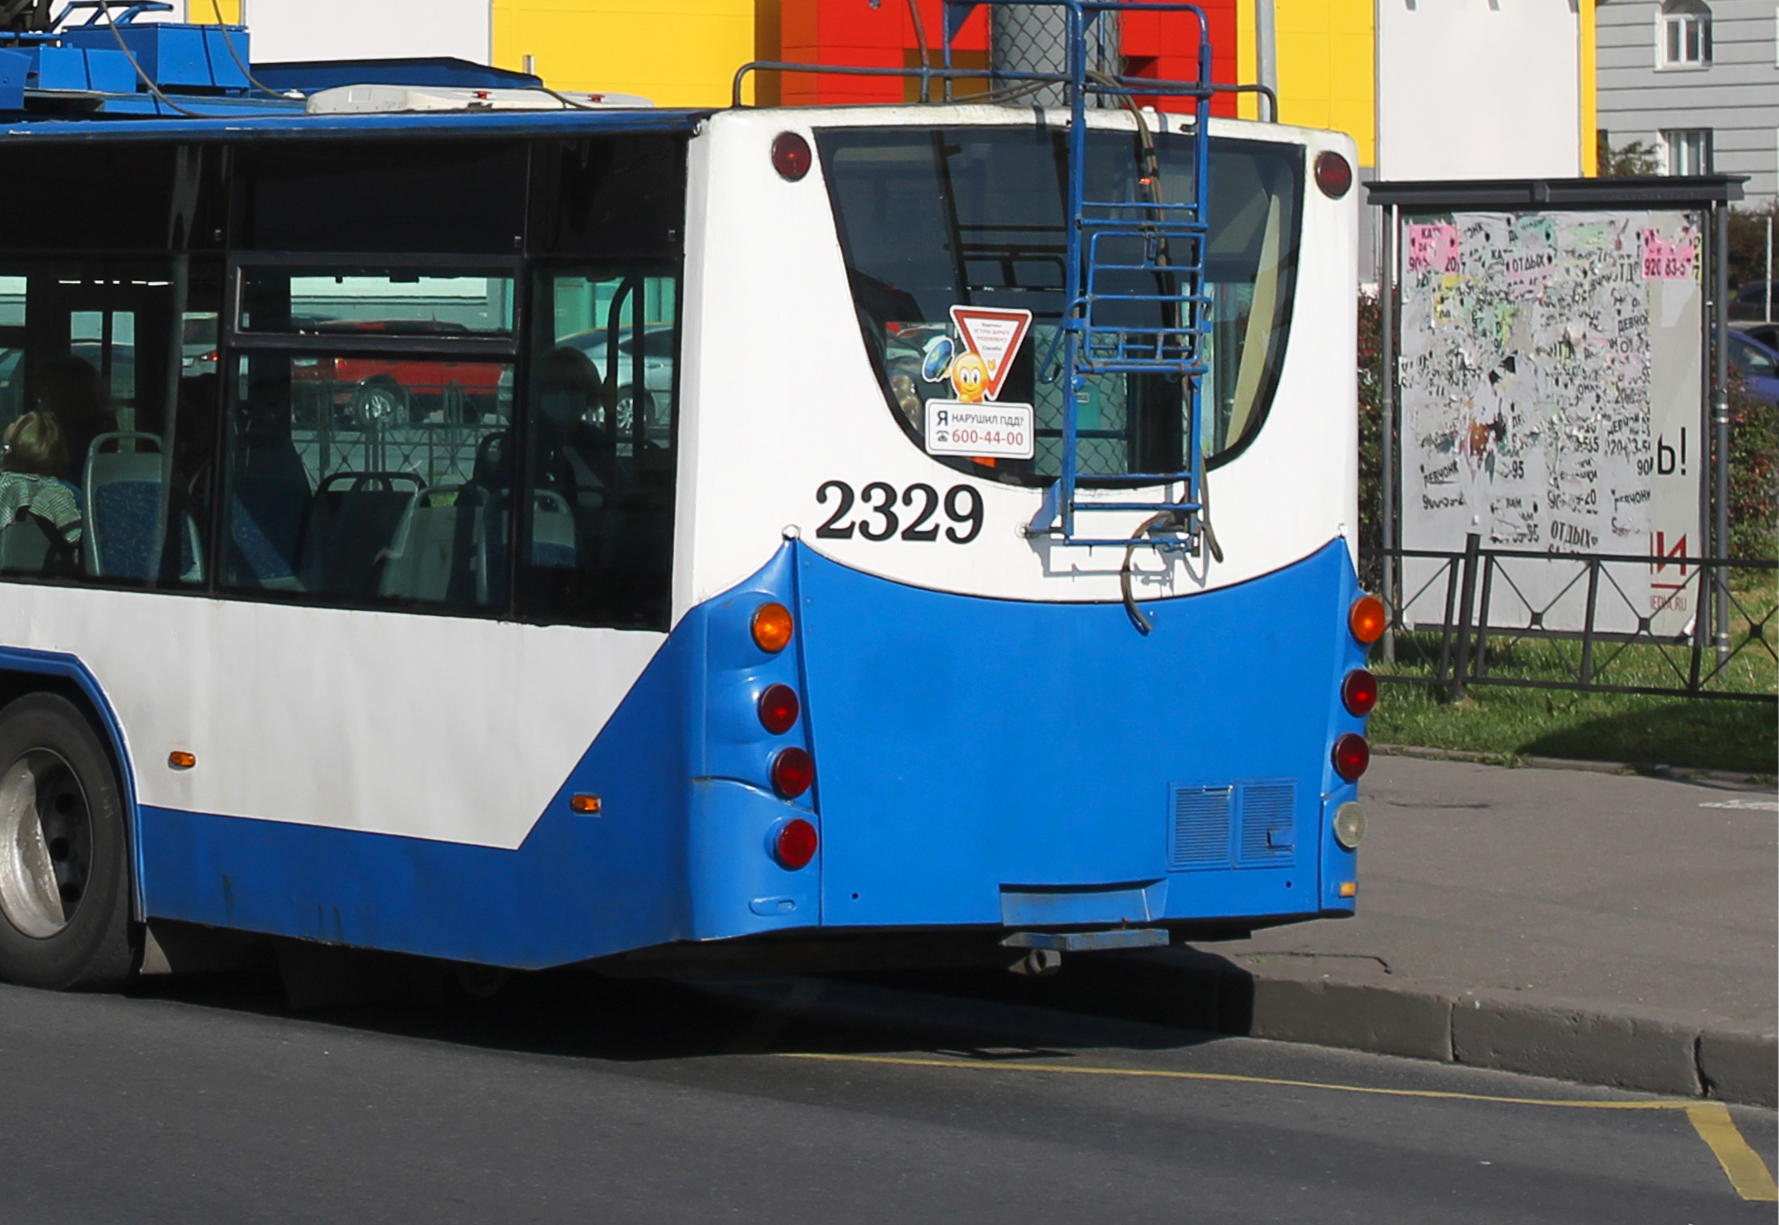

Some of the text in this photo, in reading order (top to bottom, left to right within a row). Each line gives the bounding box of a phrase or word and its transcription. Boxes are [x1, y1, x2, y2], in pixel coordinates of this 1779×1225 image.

[1512, 254, 1545, 273] ОТДЫХ
[936, 410, 1025, 428] Я НАРУШИЛ ПДД?
[952, 429, 1024, 446] 600-44-00
[815, 479, 984, 544] 2329
